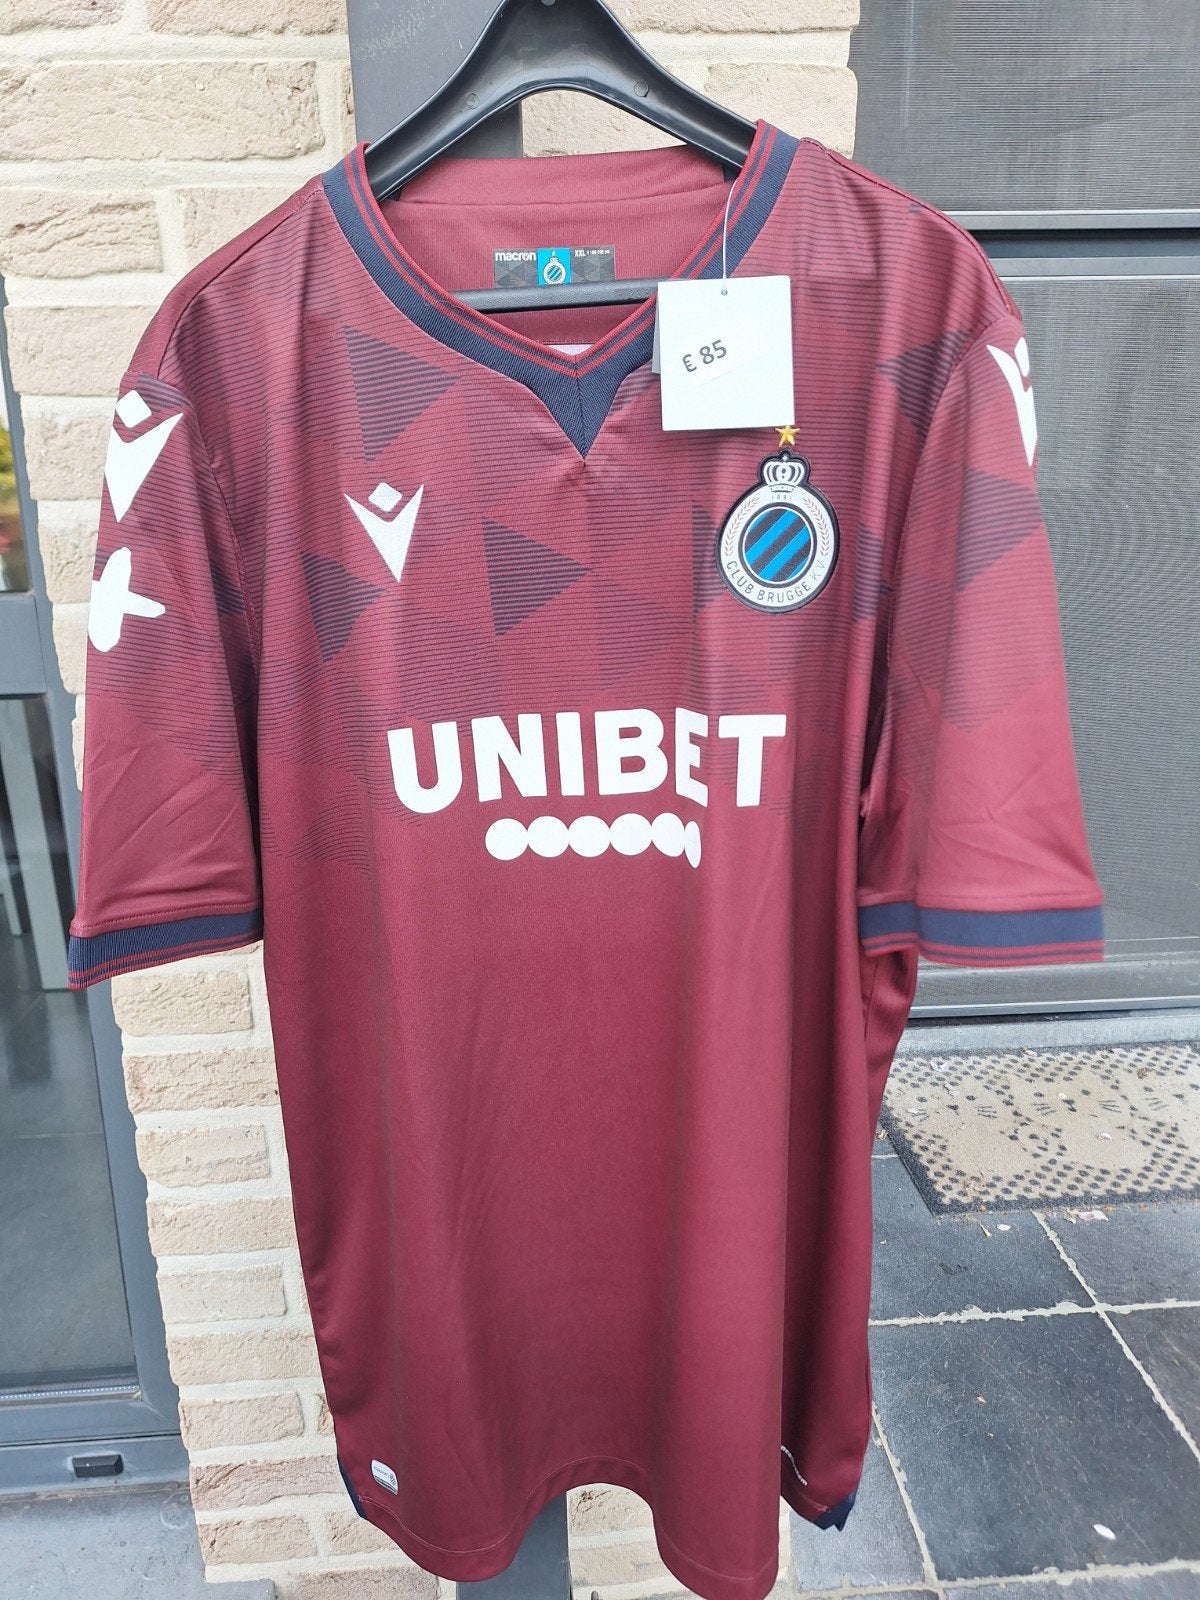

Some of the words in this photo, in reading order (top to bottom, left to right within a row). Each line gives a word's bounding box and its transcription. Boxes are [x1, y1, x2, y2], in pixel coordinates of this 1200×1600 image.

[495, 251, 537, 262] macron
[574, 249, 587, 258] XXL
[699, 339, 728, 365] 85
[726, 560, 755, 594] CLUB
[756, 581, 812, 604] BRUGGE
[386, 706, 788, 814] UNIBET
